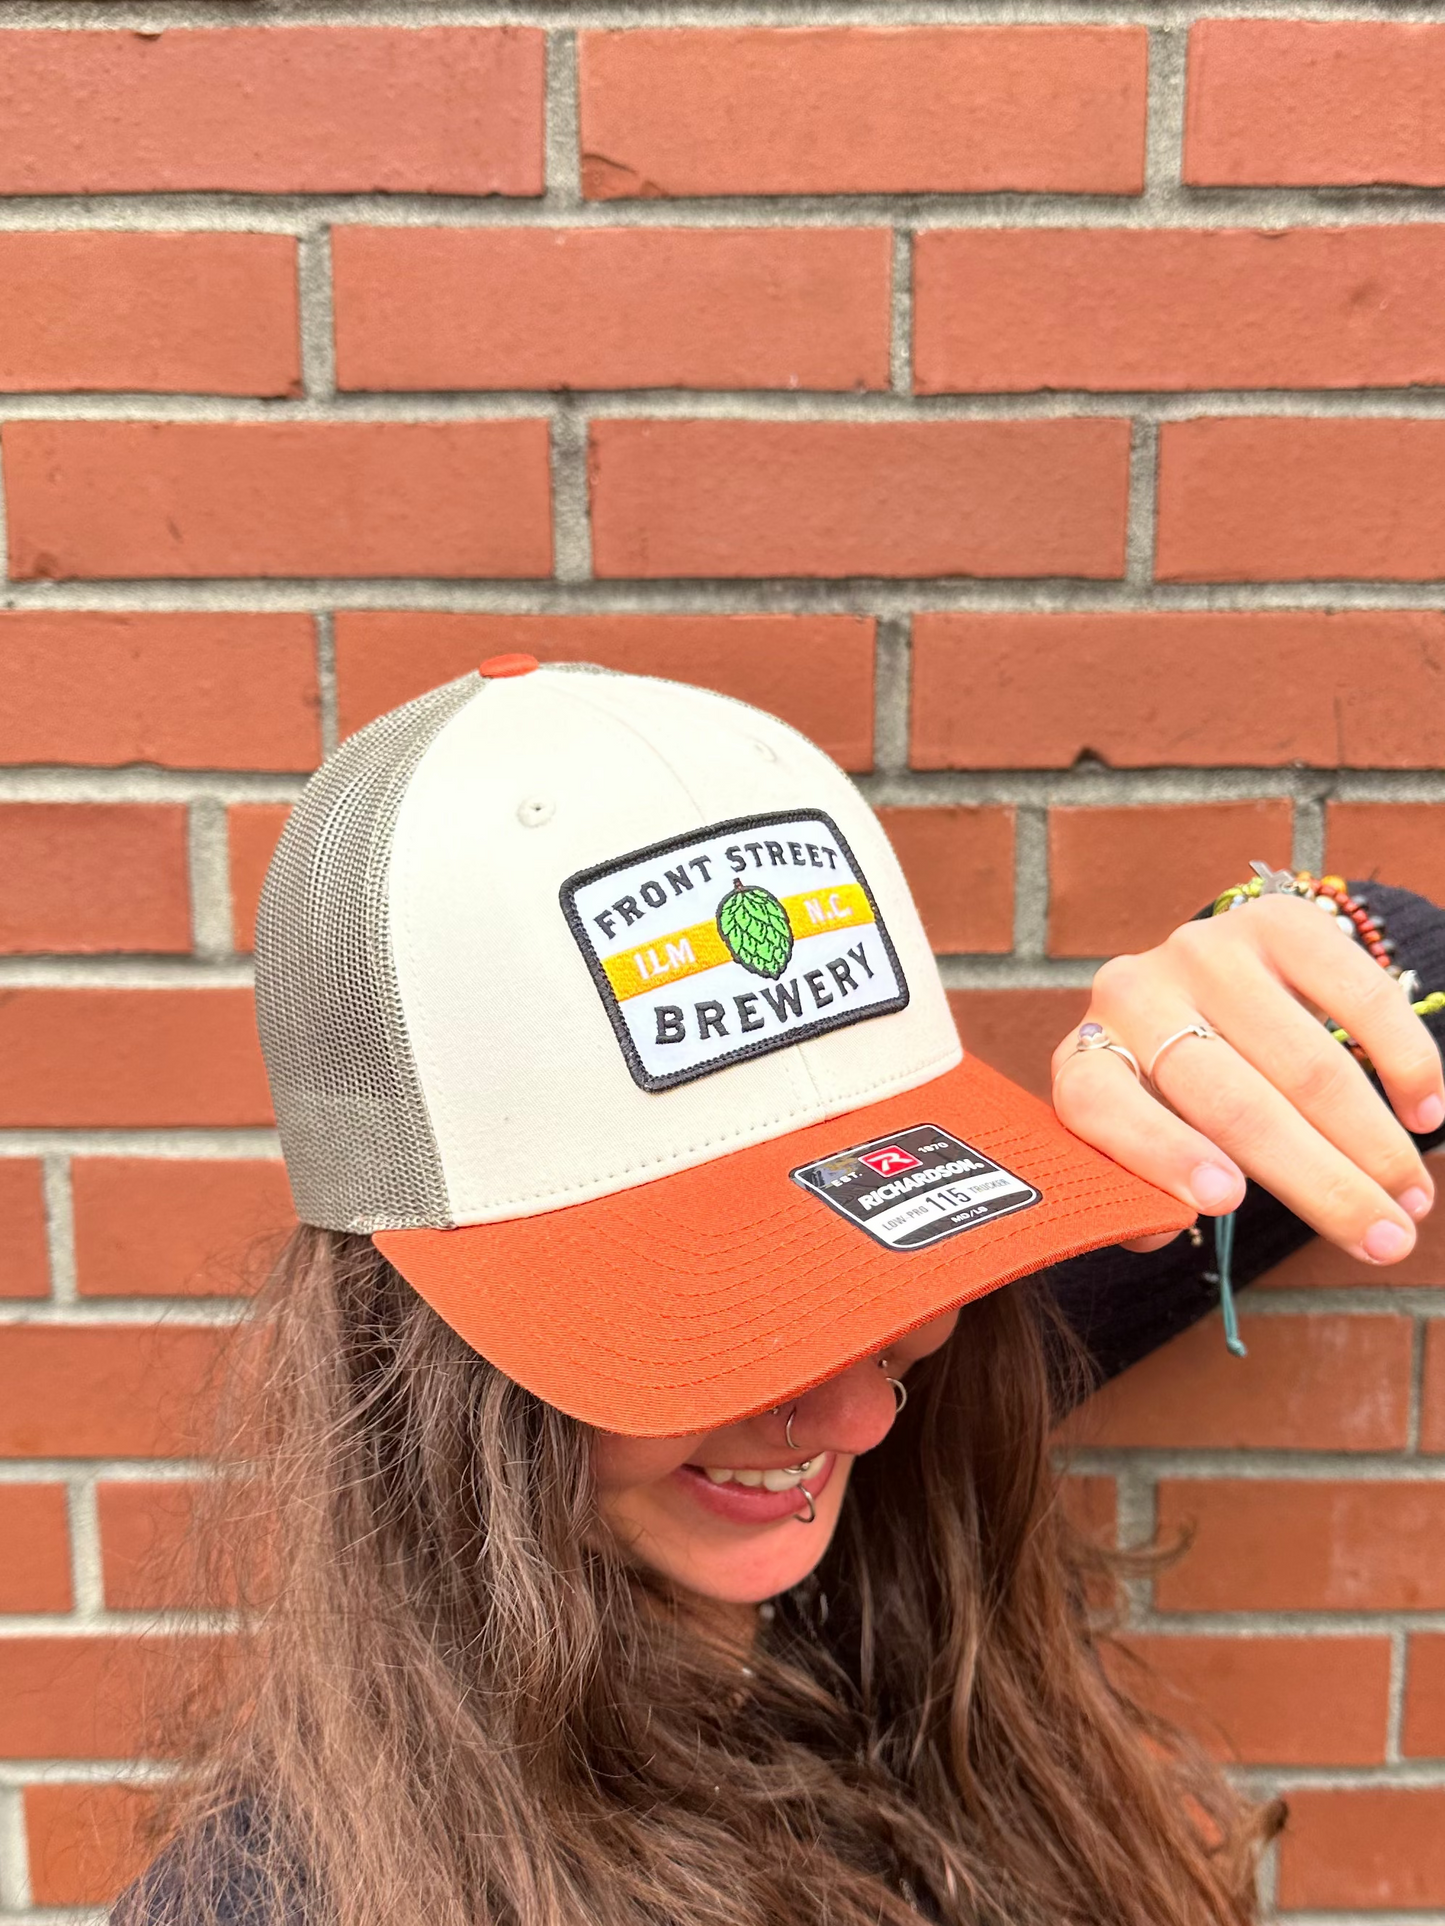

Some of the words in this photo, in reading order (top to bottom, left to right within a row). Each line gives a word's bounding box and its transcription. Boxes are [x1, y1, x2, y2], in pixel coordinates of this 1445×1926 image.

[593, 855, 711, 940] FRONT
[725, 841, 838, 872] STREET
[633, 938, 696, 981] ILM
[654, 942, 875, 1045] BREWERY
[925, 1187, 972, 1212] 115
[967, 1178, 1012, 1195] TRUCKER
